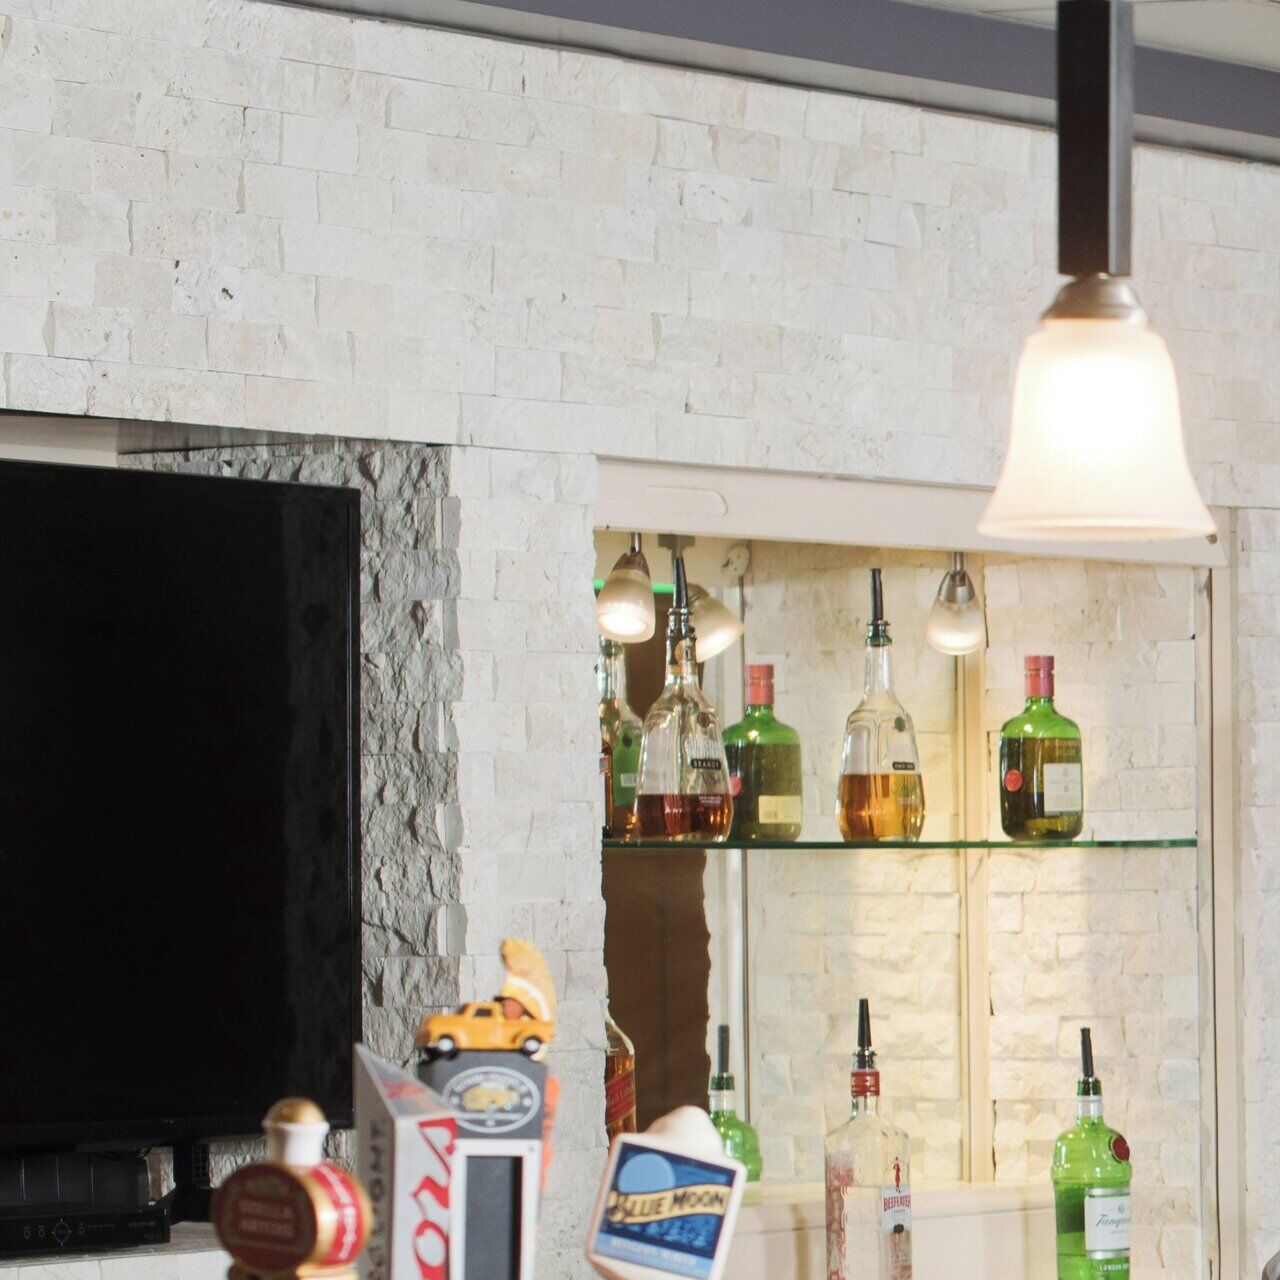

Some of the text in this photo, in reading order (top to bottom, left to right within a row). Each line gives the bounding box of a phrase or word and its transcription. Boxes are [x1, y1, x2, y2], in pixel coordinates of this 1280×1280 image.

[693, 759, 720, 769] BRANDY
[607, 1190, 724, 1223] BLUE MOON
